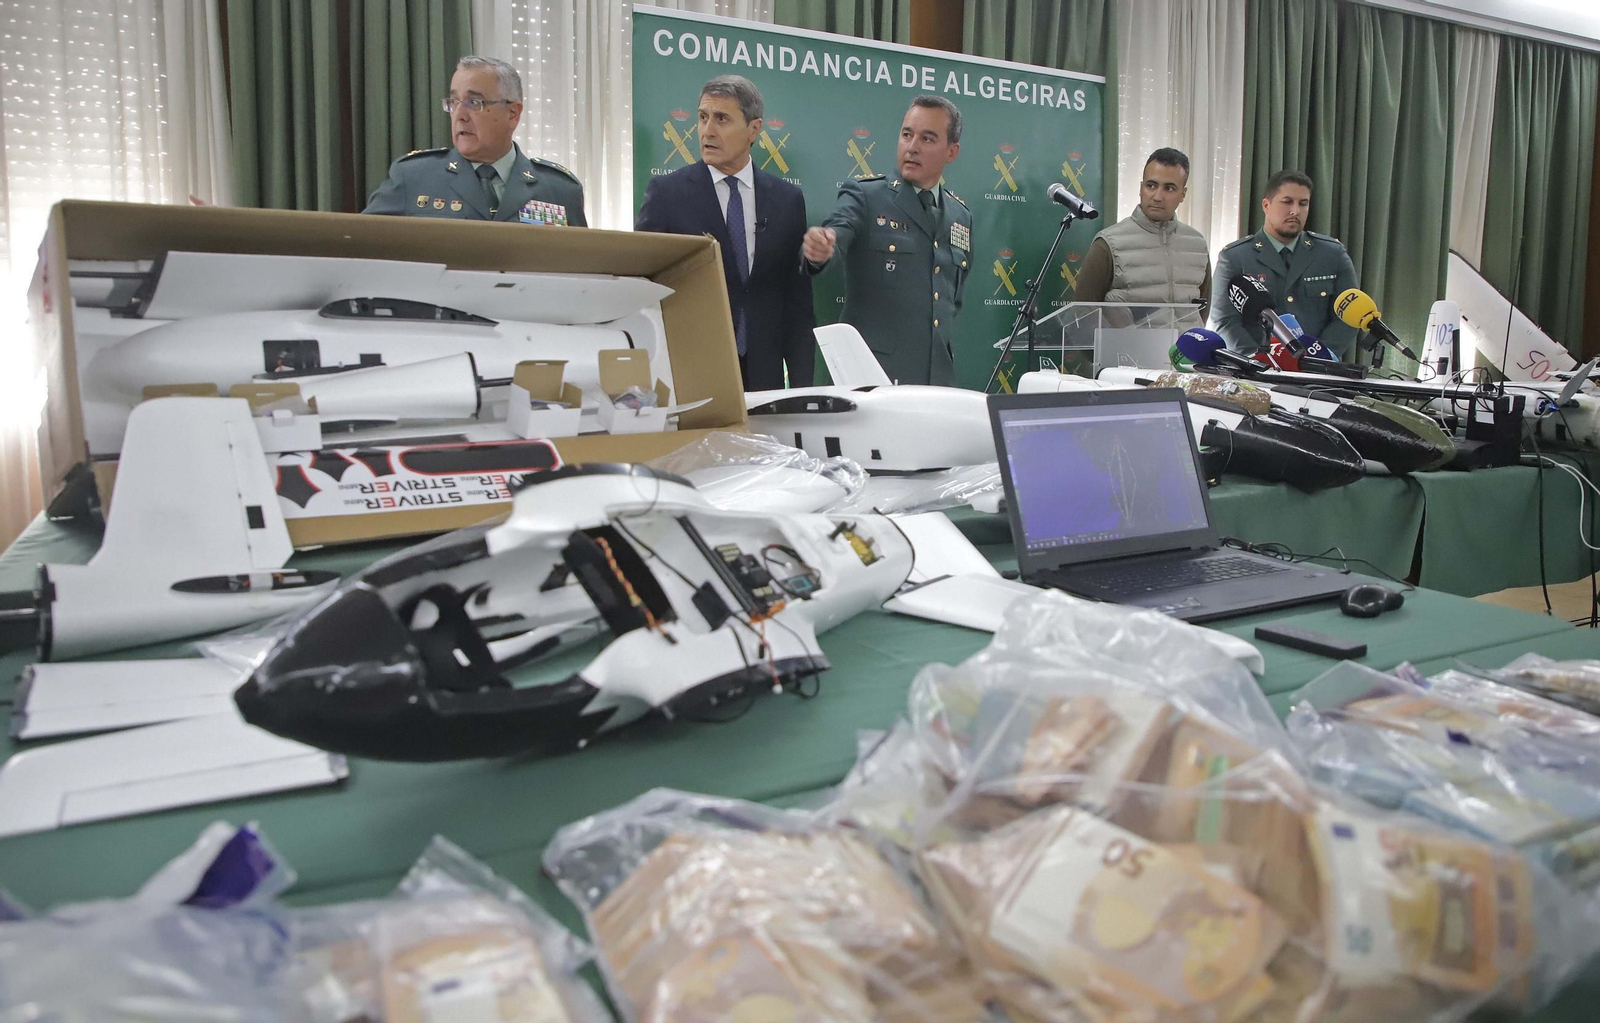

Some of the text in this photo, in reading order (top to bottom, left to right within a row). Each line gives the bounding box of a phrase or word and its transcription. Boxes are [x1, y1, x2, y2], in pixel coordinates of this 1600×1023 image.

[653, 29, 1086, 112] COMANDANCIA DE ALGECIRAS
[984, 193, 1010, 201] GUARDIA
[1337, 292, 1359, 318] SER
[1435, 323, 1454, 346] 103
[360, 477, 457, 494] STRIVER
[364, 492, 463, 510] STRIVER
[1101, 837, 1156, 880] 50
